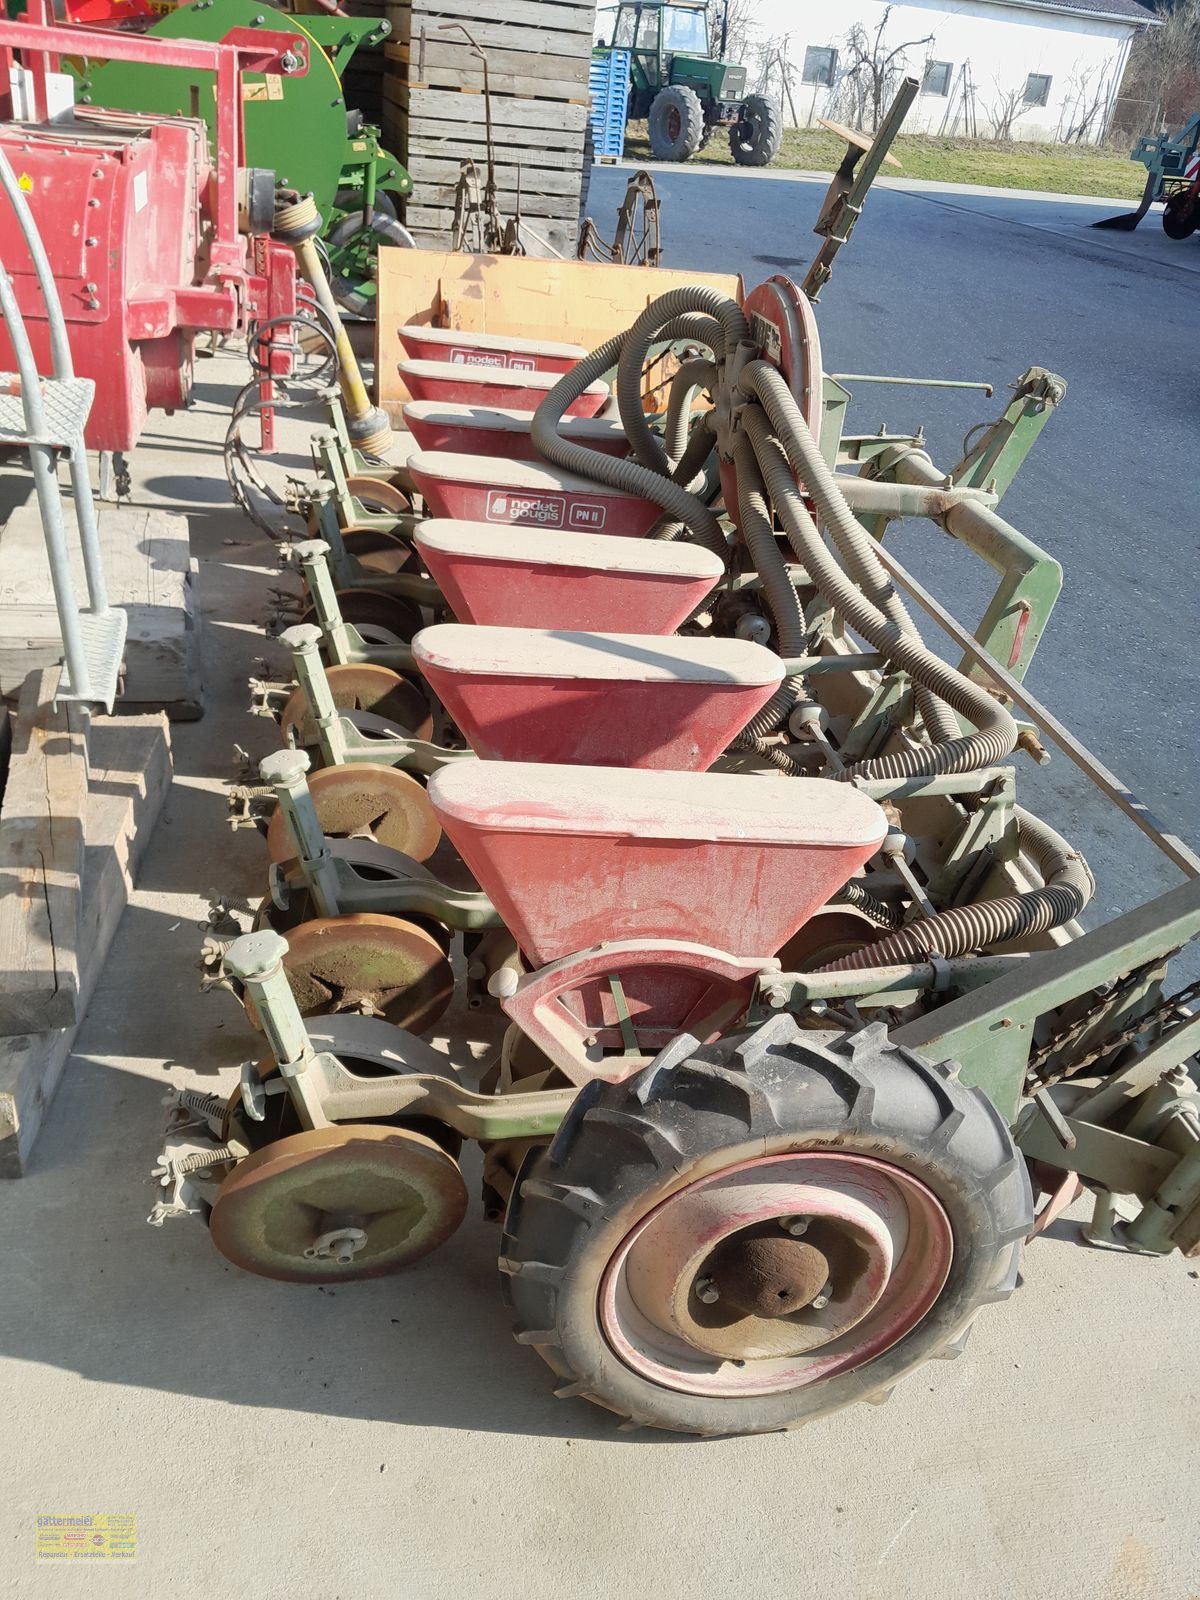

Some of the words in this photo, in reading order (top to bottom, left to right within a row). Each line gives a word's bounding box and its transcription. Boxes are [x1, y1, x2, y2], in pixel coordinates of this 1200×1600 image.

[467, 355, 501, 365] nodet
[511, 499, 559, 513] nodet
[509, 508, 559, 521] gougis
[576, 510, 589, 520] PN
